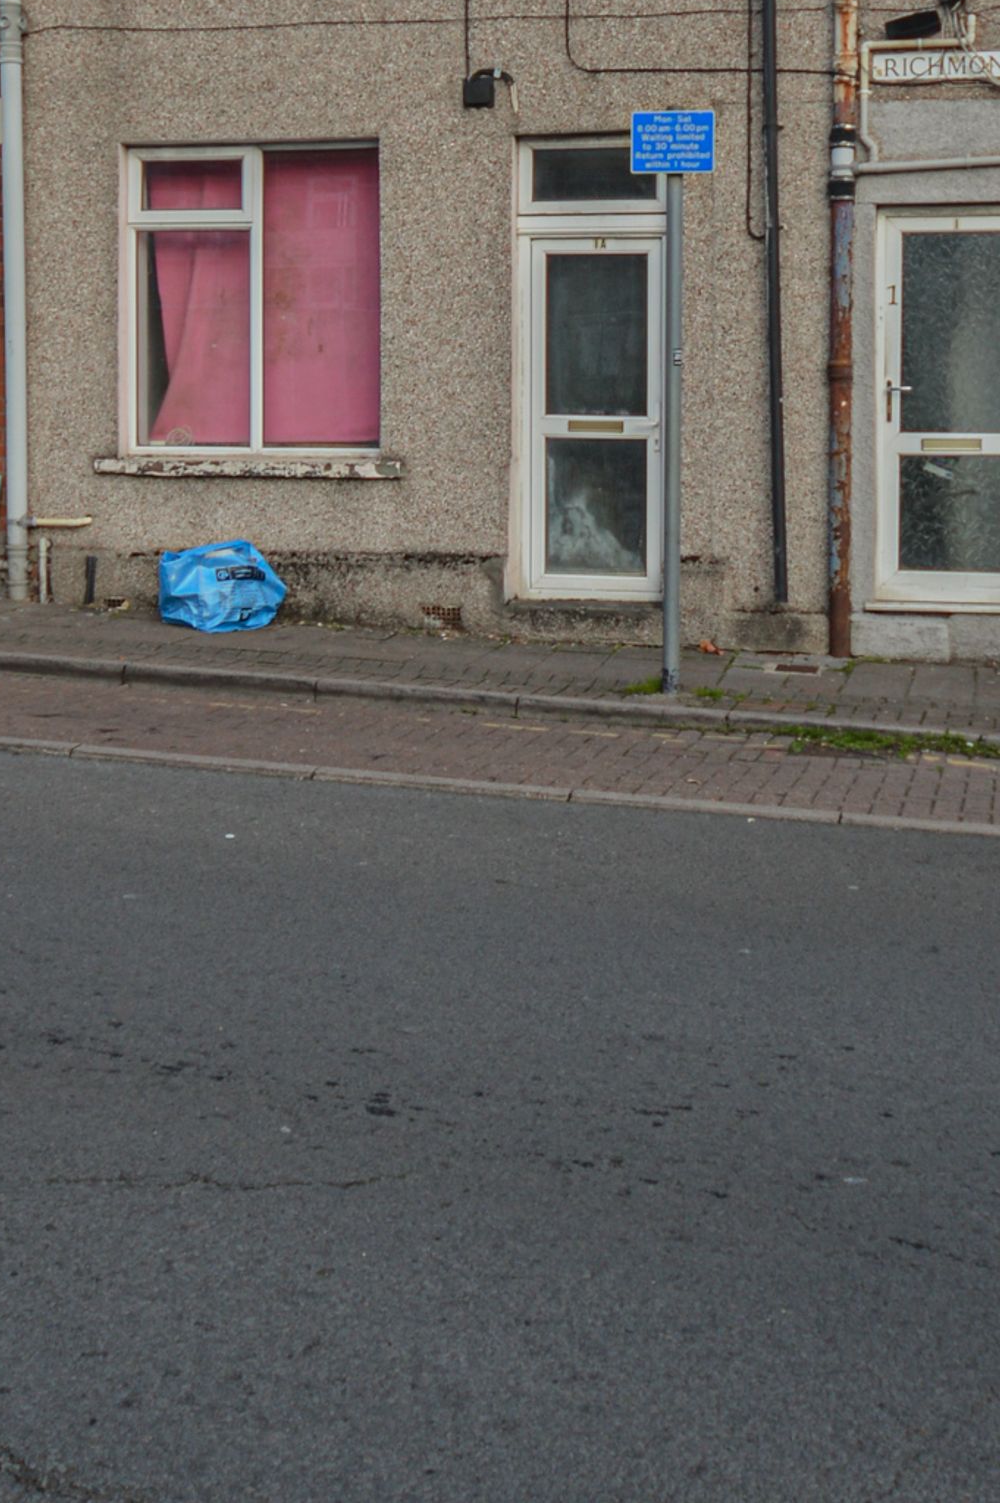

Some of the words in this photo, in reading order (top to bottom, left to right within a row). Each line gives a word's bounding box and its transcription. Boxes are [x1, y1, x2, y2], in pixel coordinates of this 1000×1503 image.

[641, 133, 673, 142] Waiting
[675, 133, 706, 141] limited
[642, 143, 652, 151] to
[666, 151, 711, 160] prohibited
[645, 161, 671, 169] within
[886, 283, 899, 305] 1
